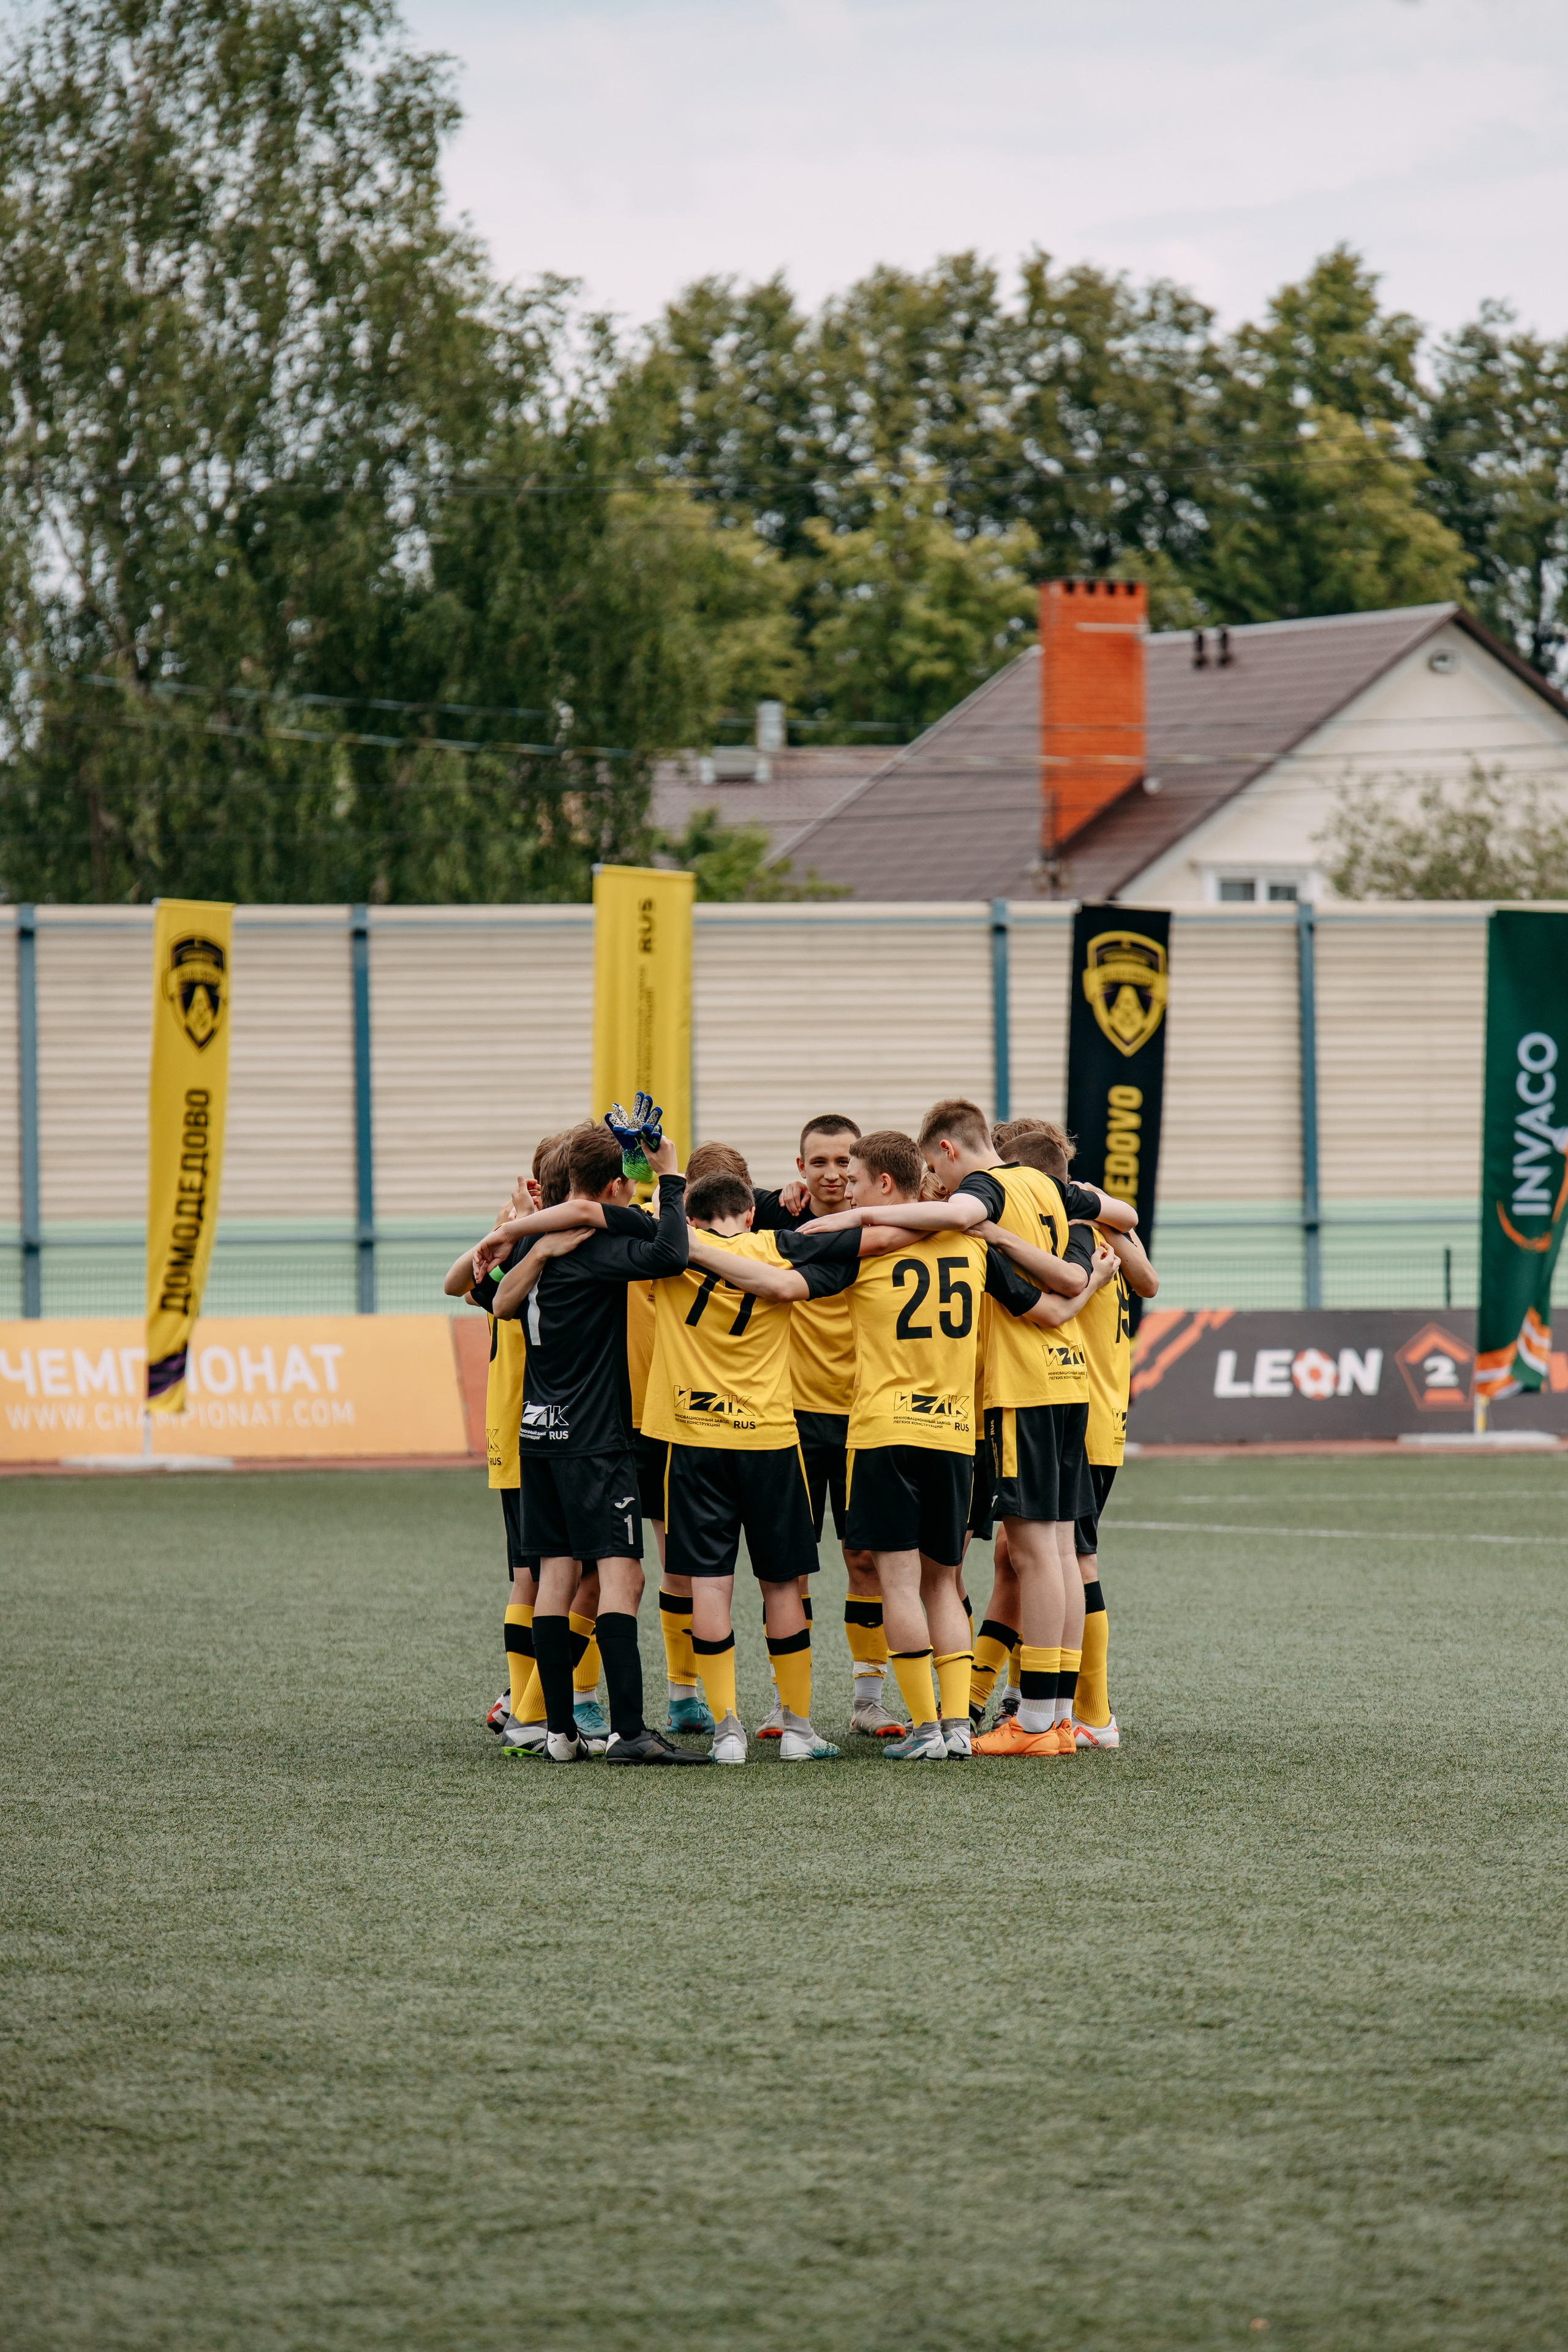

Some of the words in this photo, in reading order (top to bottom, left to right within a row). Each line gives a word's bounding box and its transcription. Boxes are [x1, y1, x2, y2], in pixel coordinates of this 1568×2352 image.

[638, 898, 654, 954] RUS
[1512, 1031, 1559, 1216] INVACO
[160, 1088, 209, 1317] ДОМОДЕДОВО
[684, 1261, 757, 1336] 77
[892, 1256, 973, 1340] 25
[1423, 1354, 1460, 1387] 2
[674, 1413, 714, 1422] ИННОВАЦИОННЫЙ
[734, 1420, 756, 1430] RUS
[893, 1415, 936, 1424] ИННОВАЦИОННЫЙ
[954, 1422, 970, 1432] RUS
[549, 1430, 570, 1440] RUS
[489, 1457, 502, 1466] RUS
[624, 1514, 634, 1545] 1
